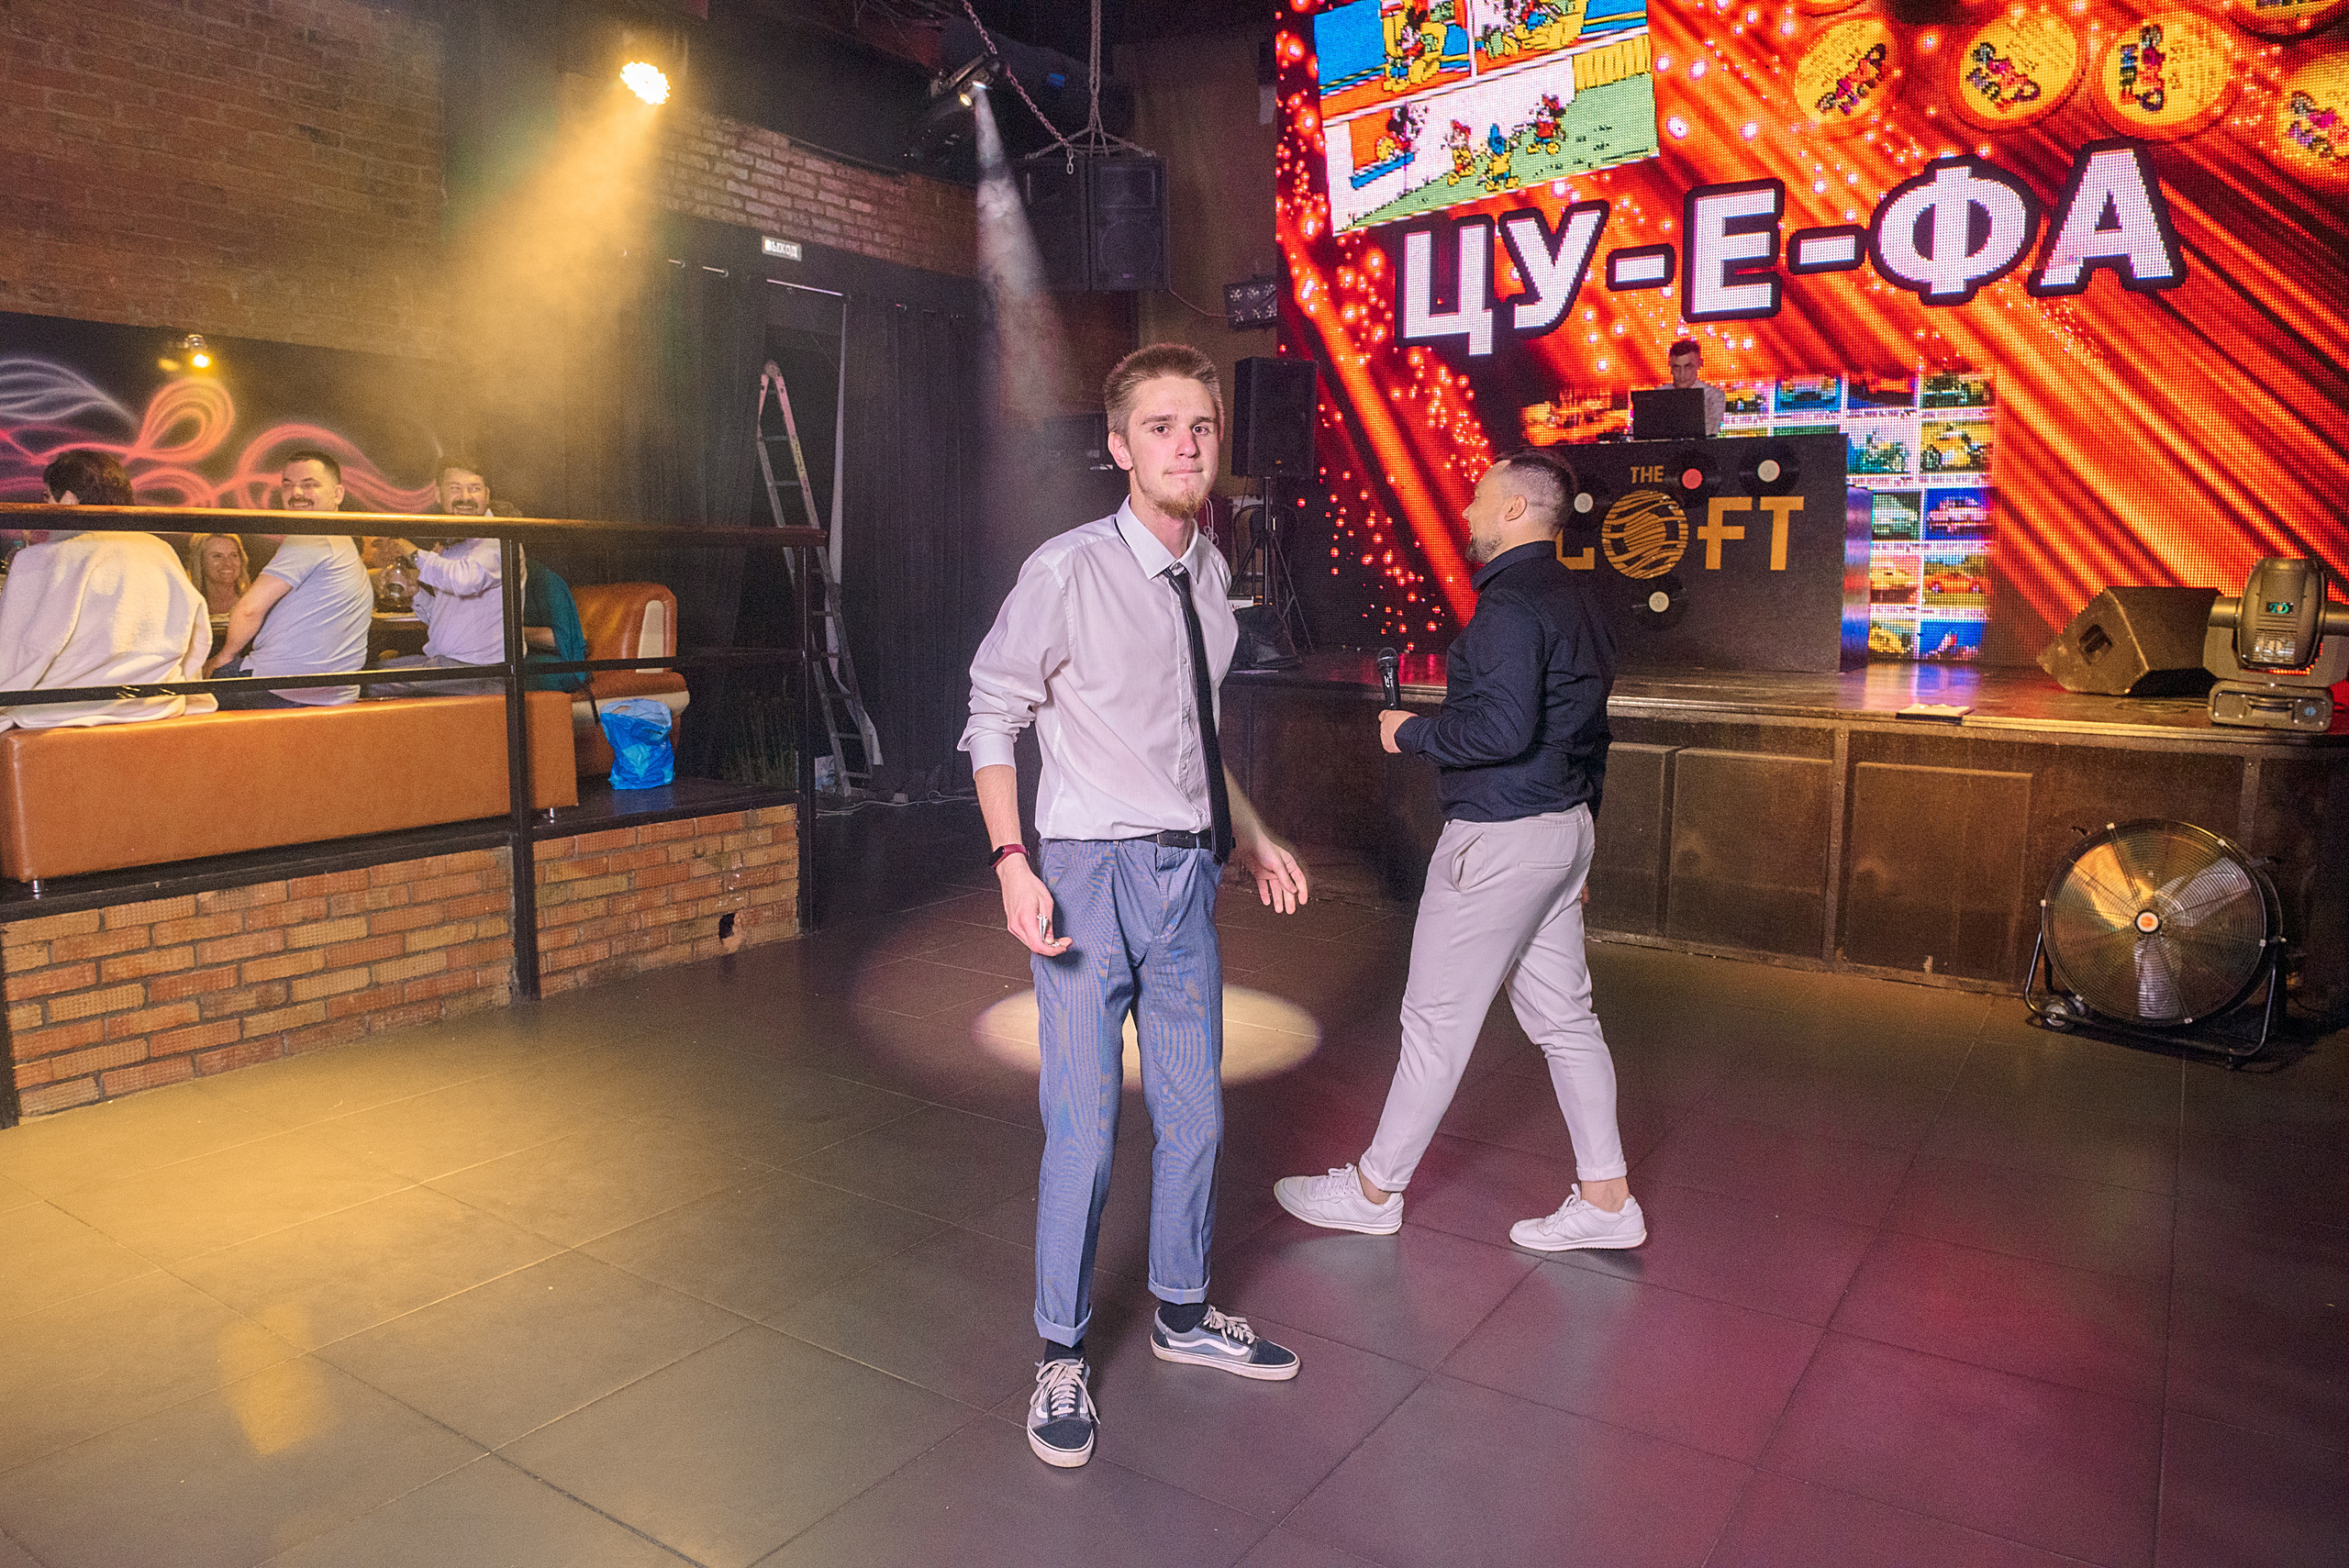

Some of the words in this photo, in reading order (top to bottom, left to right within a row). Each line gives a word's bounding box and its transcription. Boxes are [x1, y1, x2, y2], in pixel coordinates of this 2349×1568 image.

[764, 239, 798, 258] ВЫХОД
[1400, 147, 2176, 357] ЦУ-Е-ФА
[1631, 465, 1664, 484] THE
